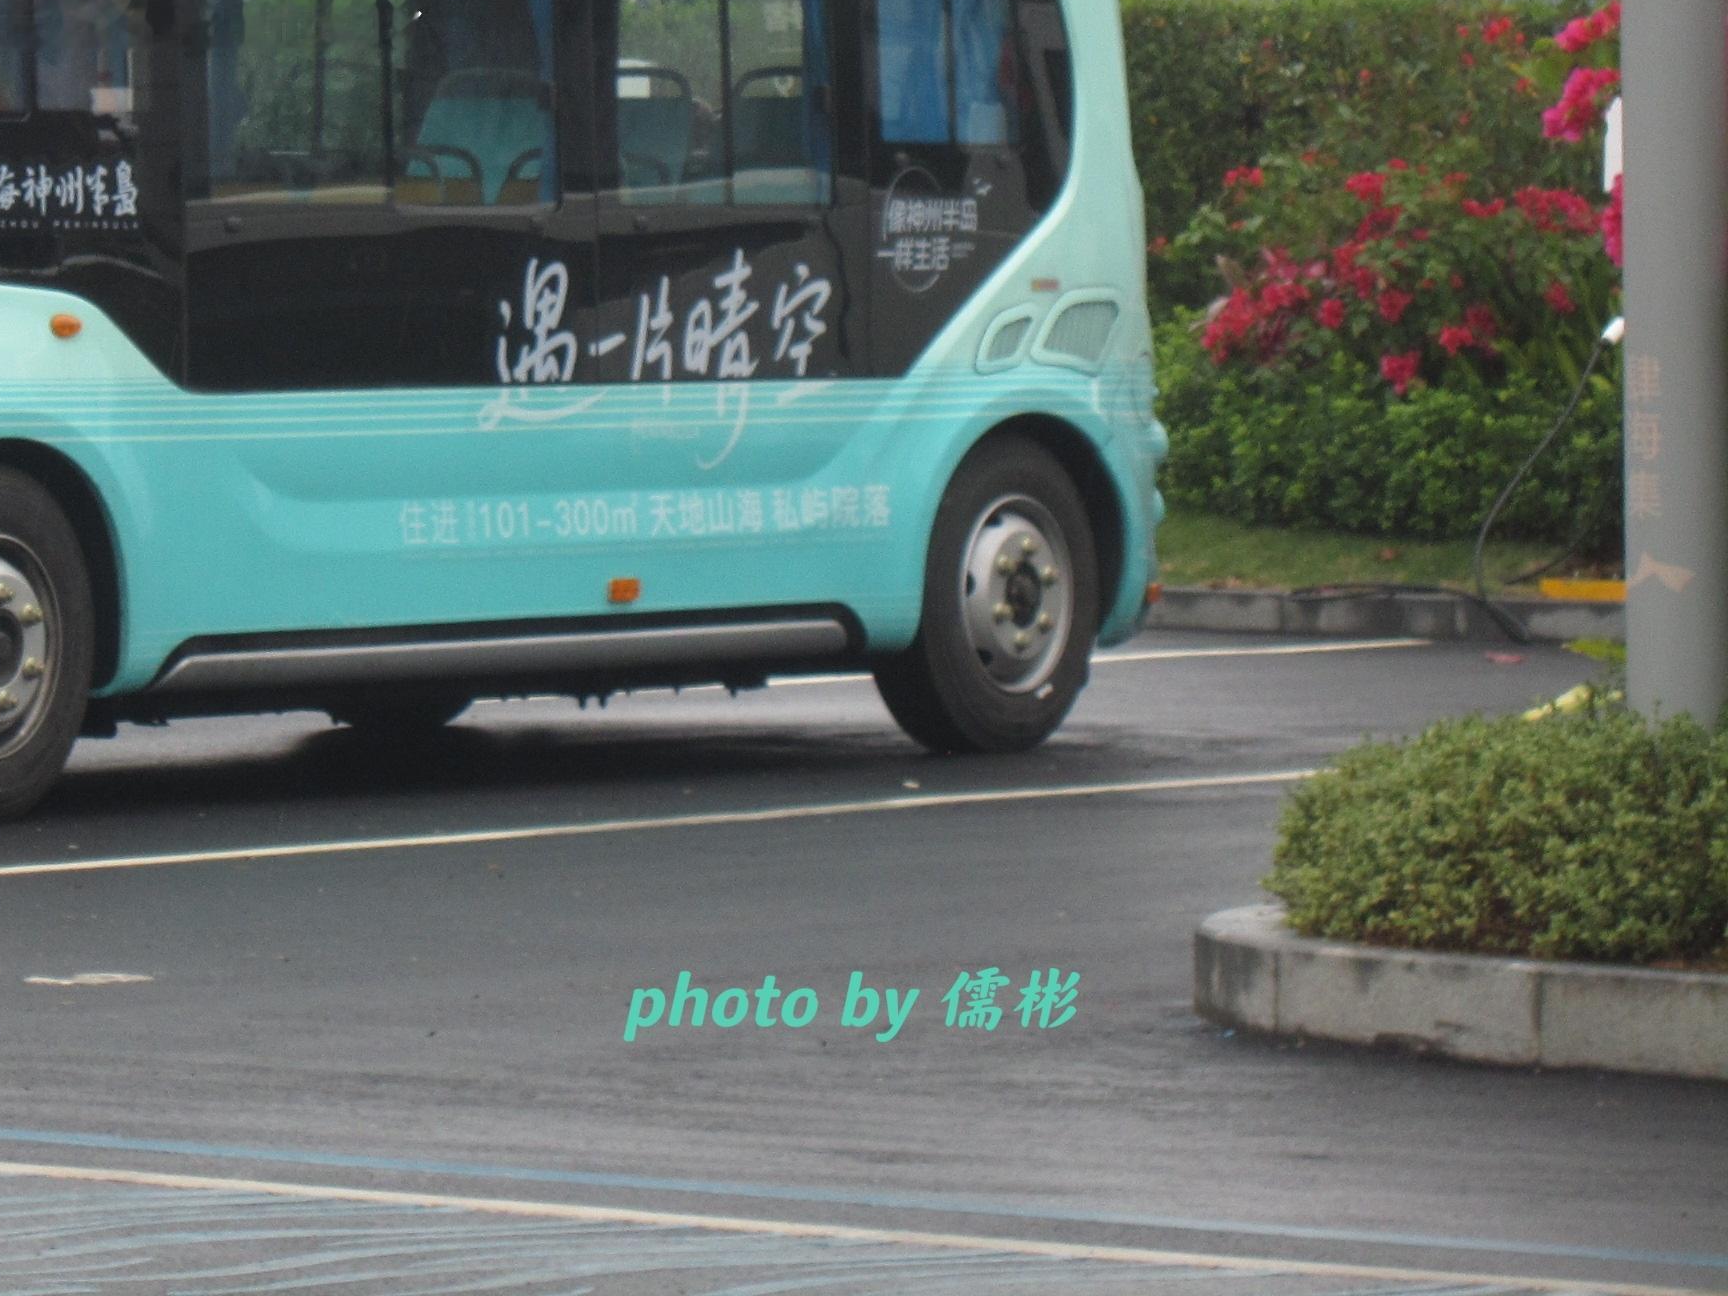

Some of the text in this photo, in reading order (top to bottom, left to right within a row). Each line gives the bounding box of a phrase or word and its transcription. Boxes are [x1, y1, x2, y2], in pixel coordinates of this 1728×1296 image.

[475, 247, 832, 470] 遇一片晴空
[399, 500, 459, 544] 住进
[649, 488, 763, 538] 天地山海
